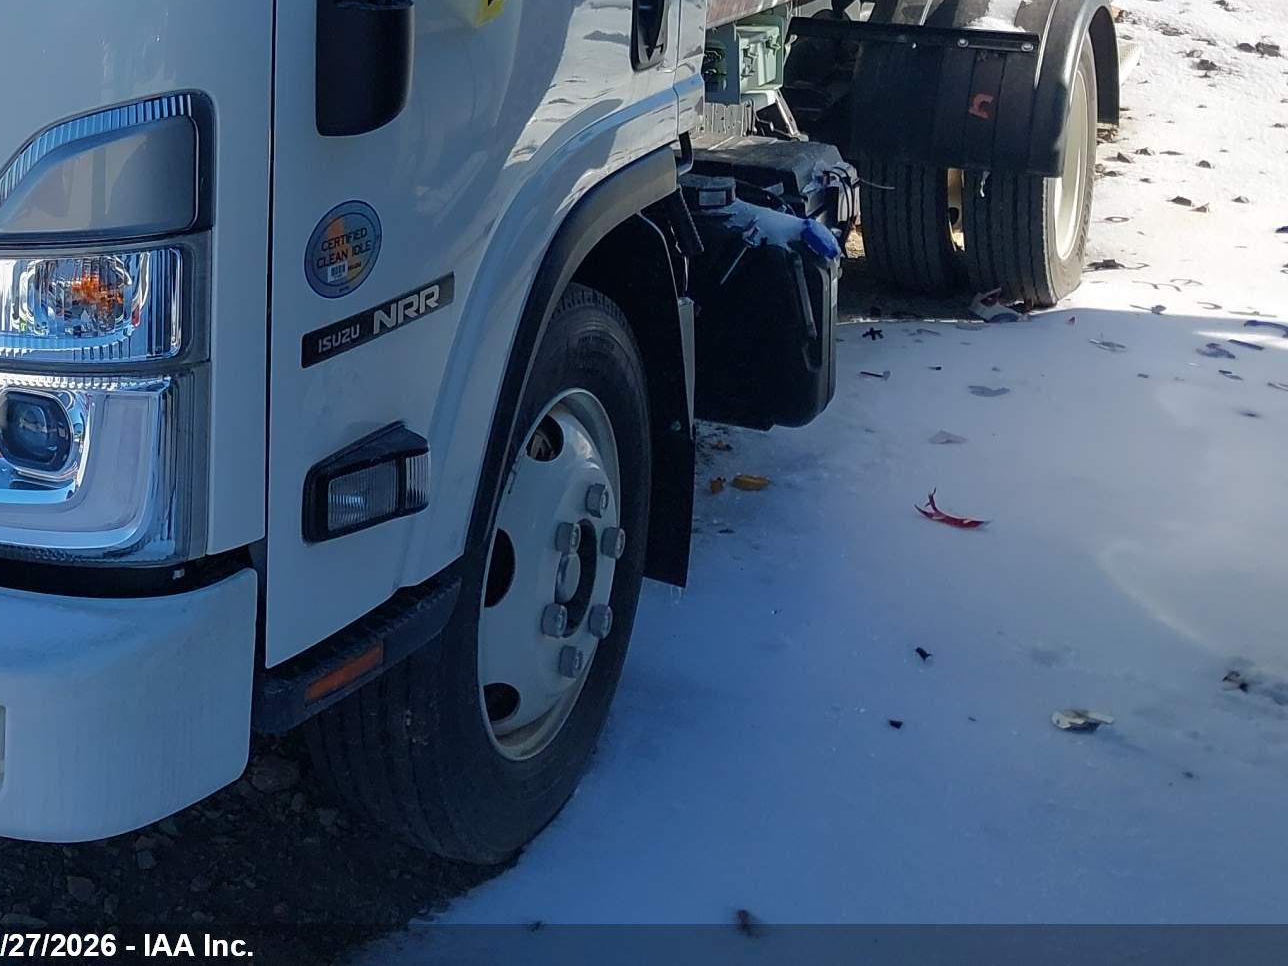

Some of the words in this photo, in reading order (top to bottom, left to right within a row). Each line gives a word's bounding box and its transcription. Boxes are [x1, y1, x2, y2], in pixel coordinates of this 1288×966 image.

[321, 227, 368, 252] CERTIFIED
[316, 248, 348, 268] CLEAN
[351, 240, 372, 258] IDLE
[317, 323, 360, 354] ISUZU
[373, 284, 440, 335] NRR
